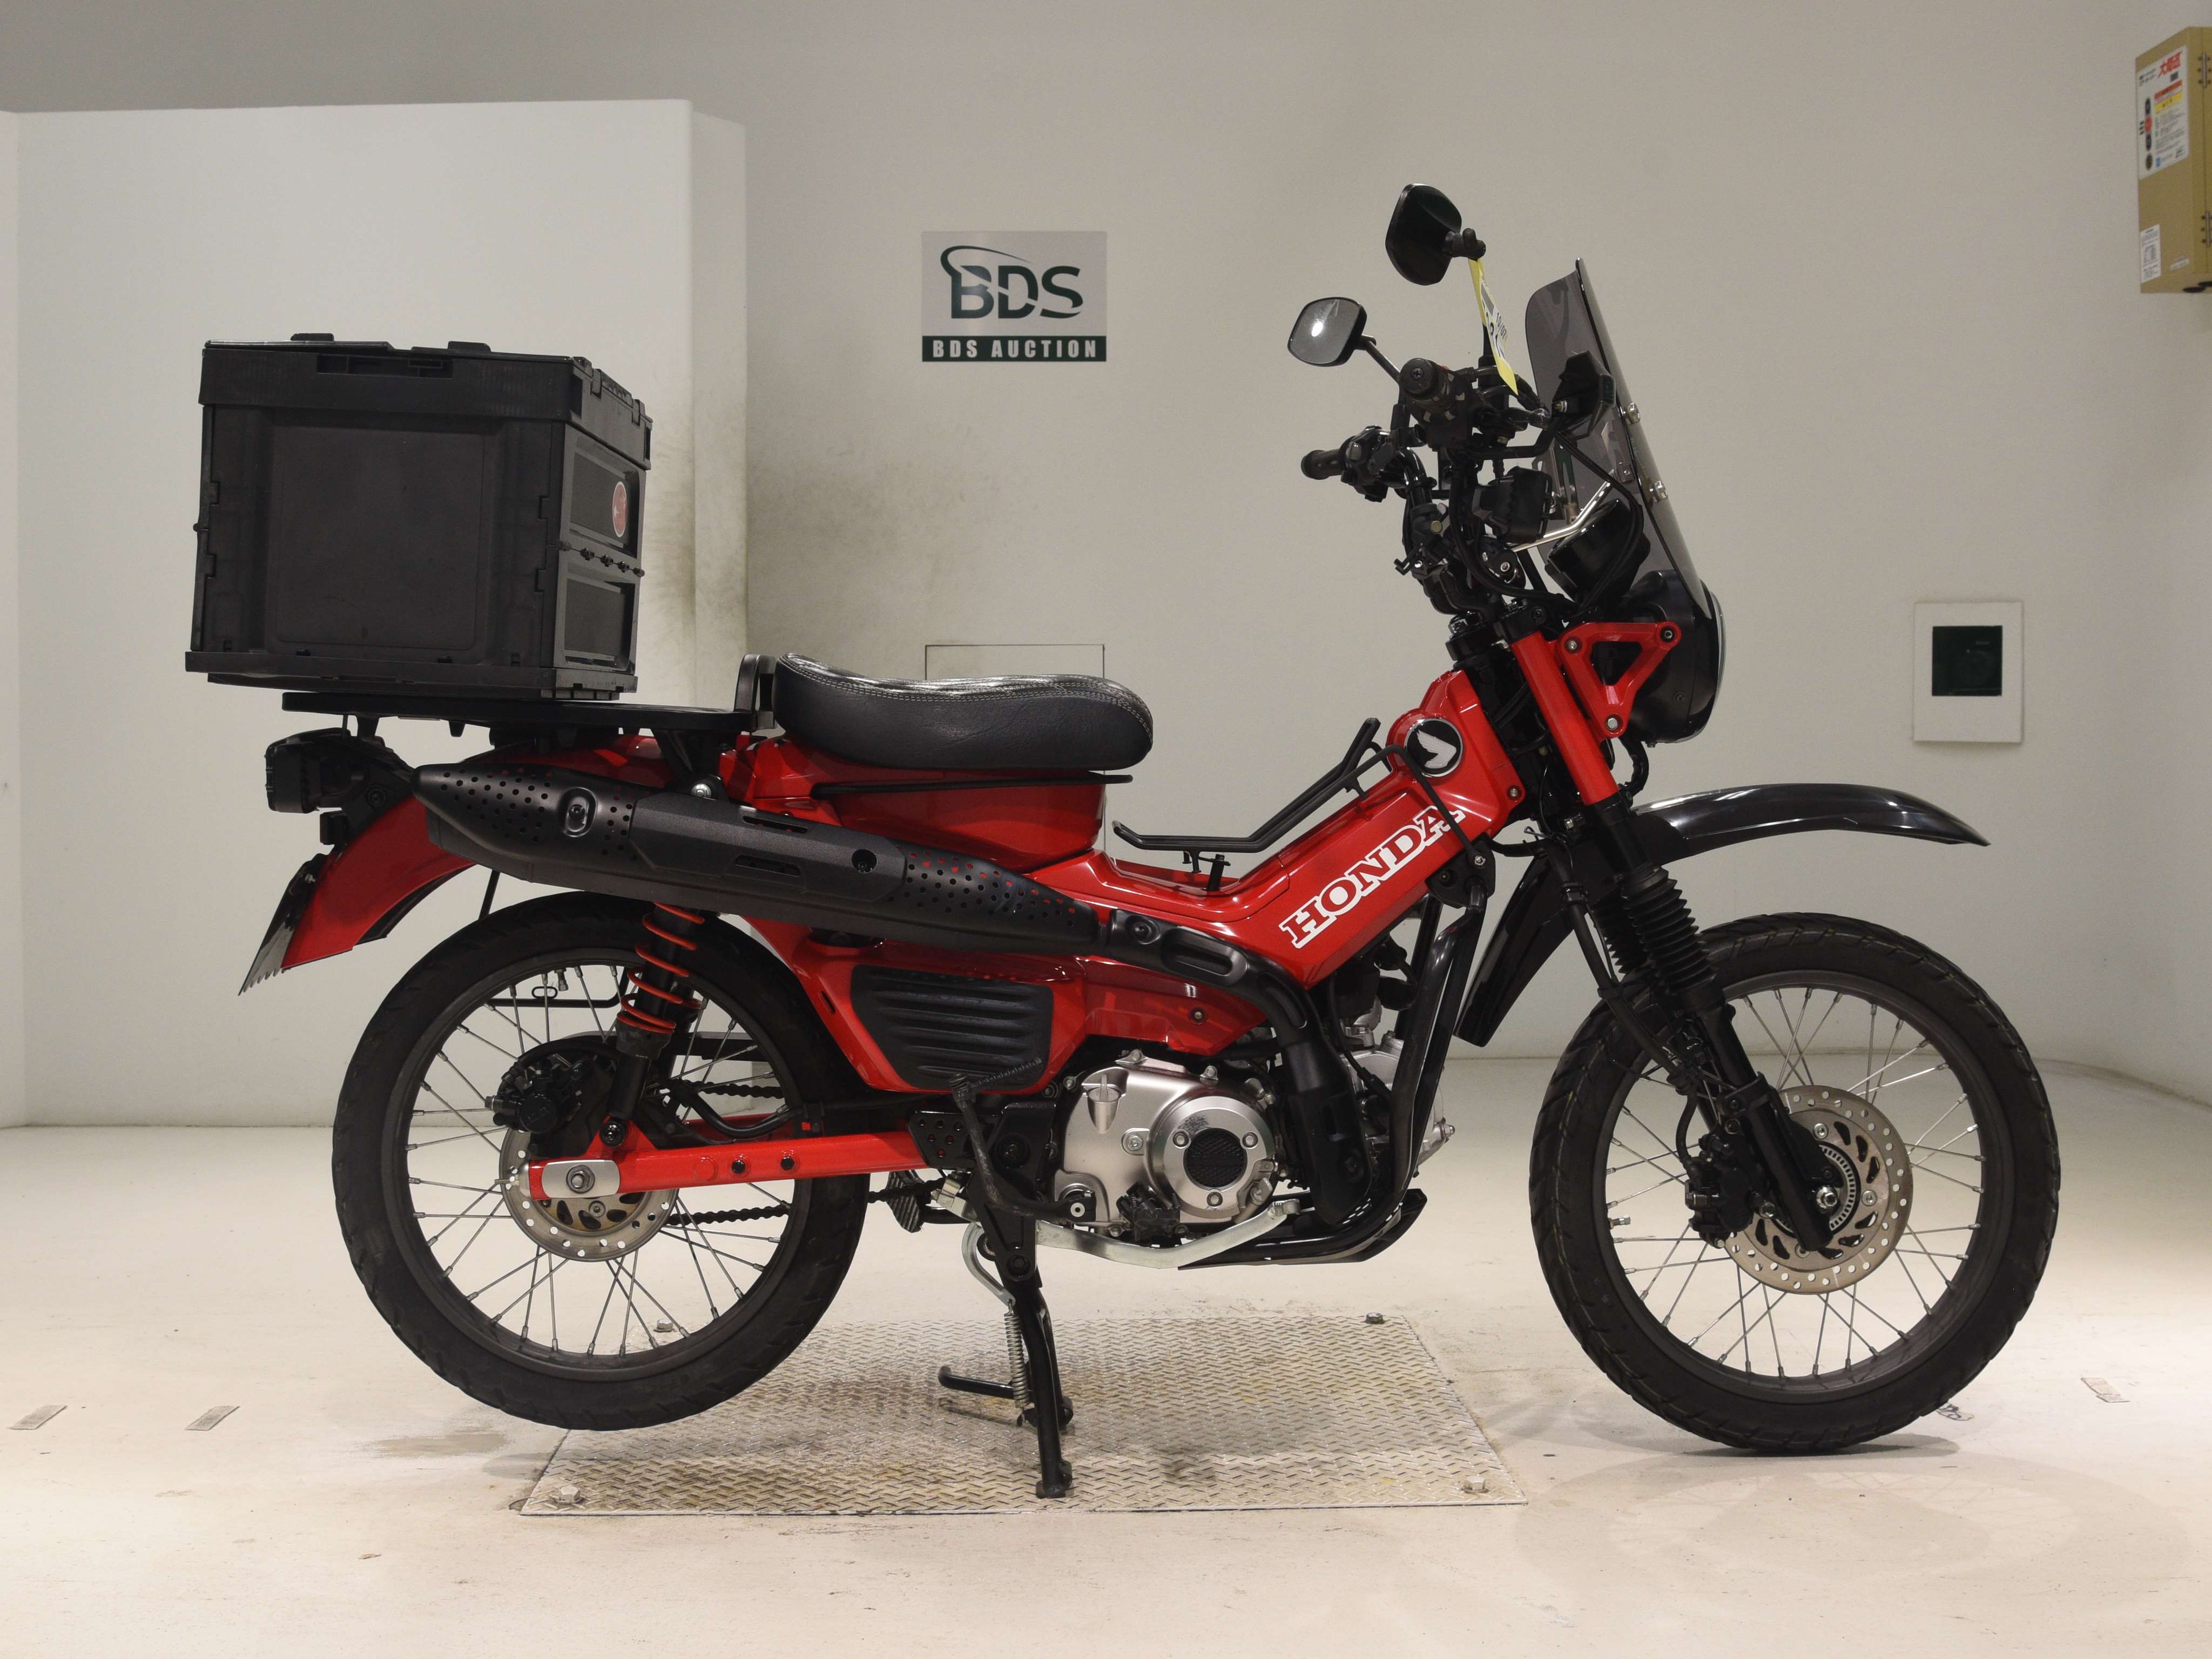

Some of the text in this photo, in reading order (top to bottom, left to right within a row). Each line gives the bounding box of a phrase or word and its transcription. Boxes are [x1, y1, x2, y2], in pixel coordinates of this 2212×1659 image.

[940, 245, 1083, 319] BDS
[933, 340, 1096, 358] BDS AUCTION
[1496, 312, 1507, 340] 10/07
[1279, 805, 1467, 949] HONDA
